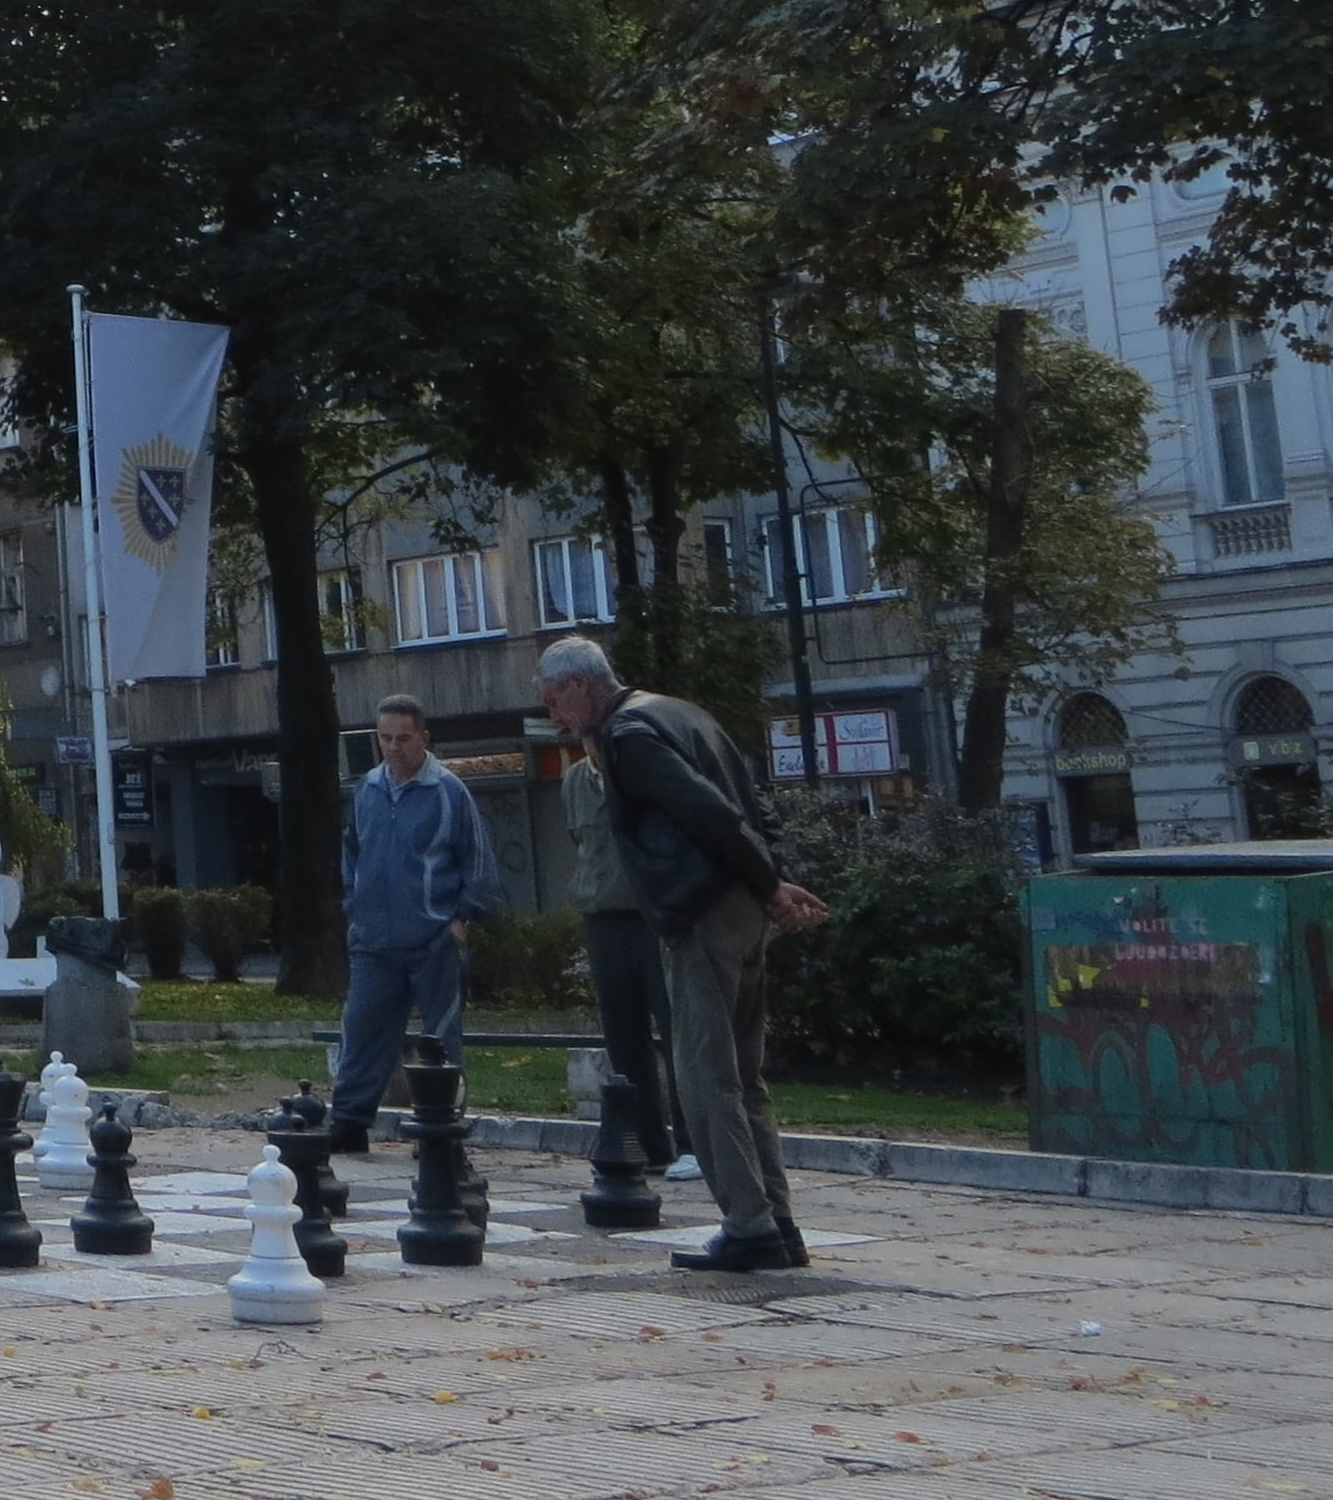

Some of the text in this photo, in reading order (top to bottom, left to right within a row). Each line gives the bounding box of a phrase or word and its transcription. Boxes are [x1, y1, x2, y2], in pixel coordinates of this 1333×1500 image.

[1053, 752, 1127, 771] bookshop
[1118, 917, 1208, 934] VOLITE SE
